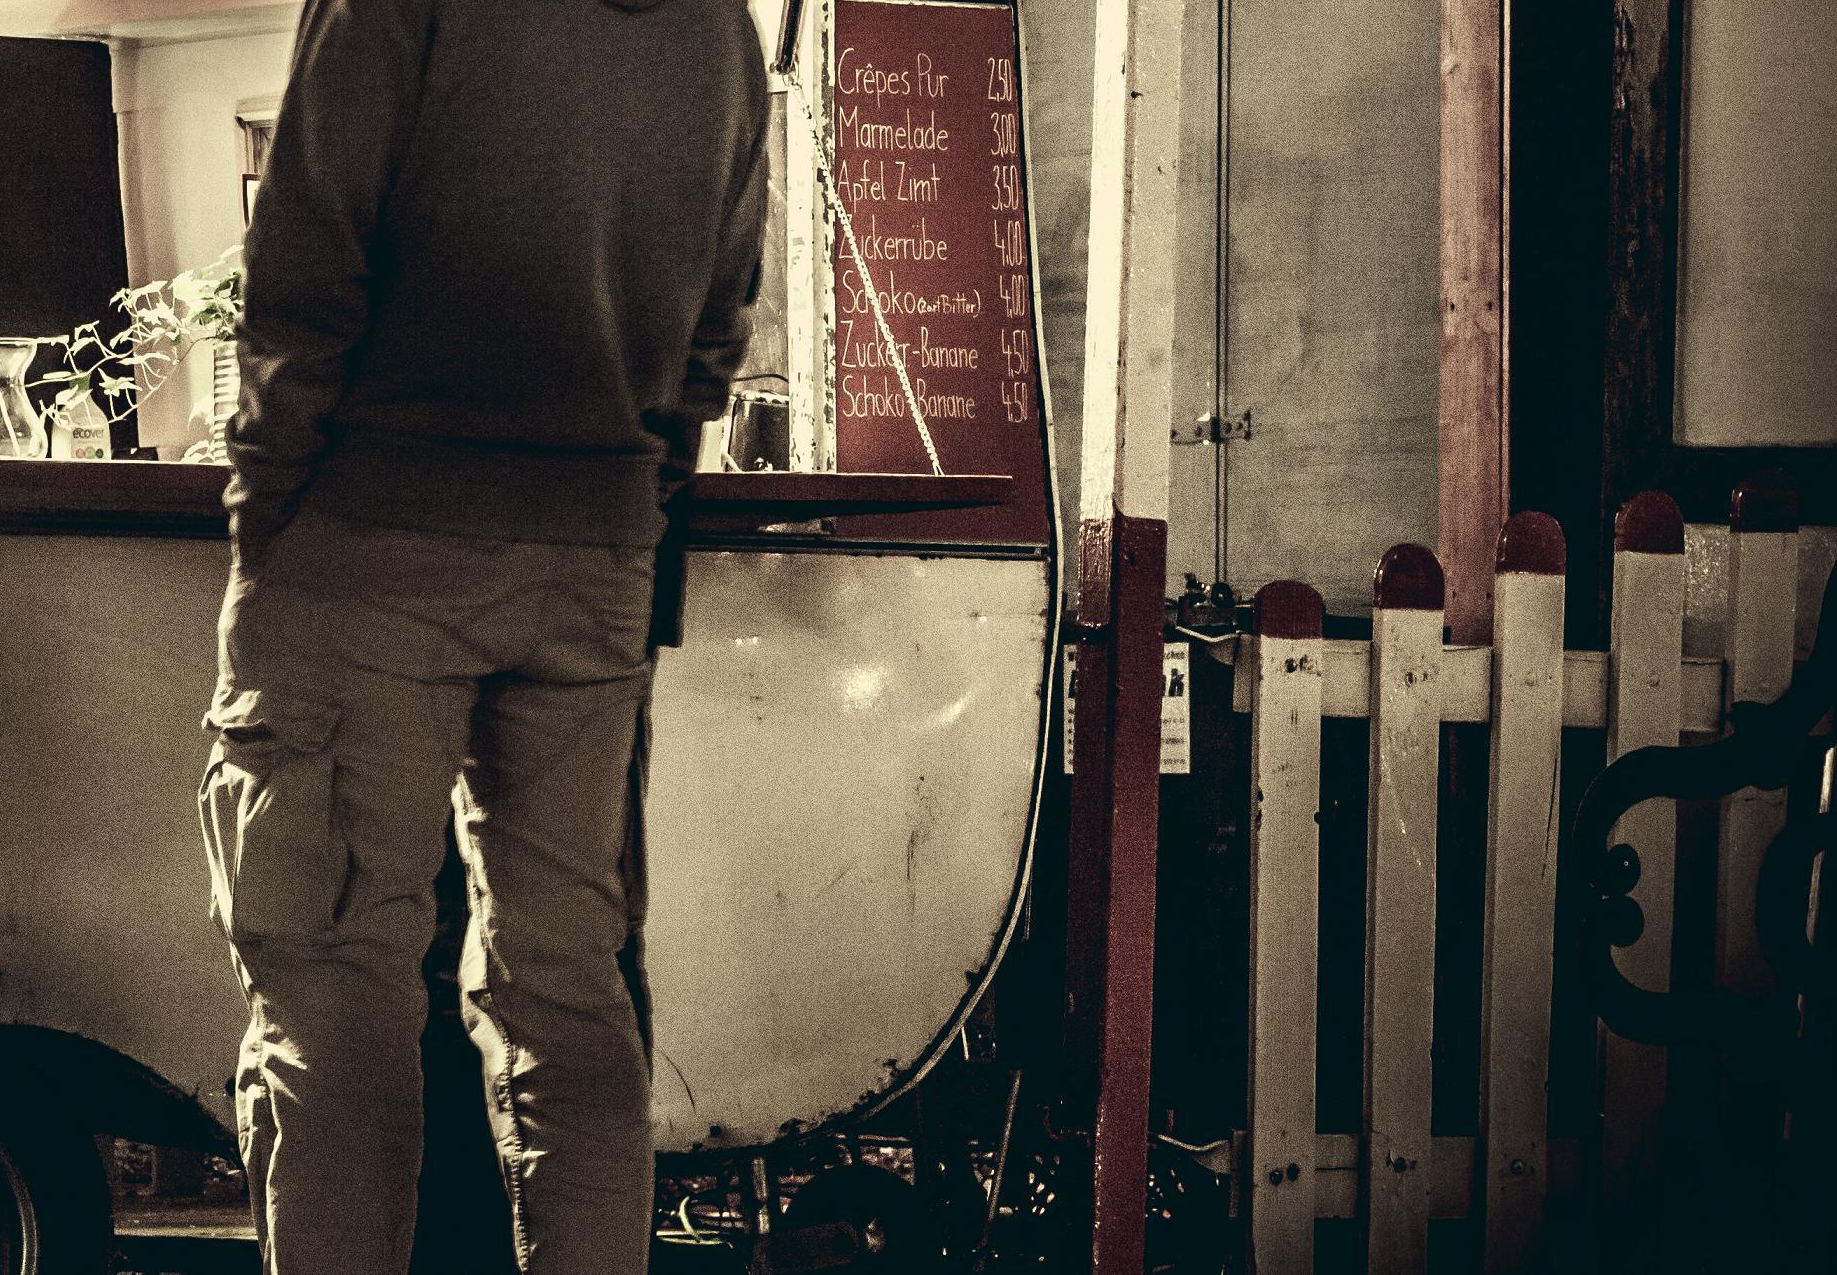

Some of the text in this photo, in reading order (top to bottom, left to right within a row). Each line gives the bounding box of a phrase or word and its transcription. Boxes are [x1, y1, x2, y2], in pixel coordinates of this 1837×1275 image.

[837, 47, 1013, 108] Crêpes Pur 2,50
[838, 105, 1017, 157] Marmelade 3,00
[837, 159, 1019, 213] Apfel Zimt 3,50
[995, 220, 1024, 268] 4,00
[1000, 274, 1026, 318] 4,00
[1002, 328, 1029, 377] 4,50
[1002, 380, 1029, 424] 4,50
